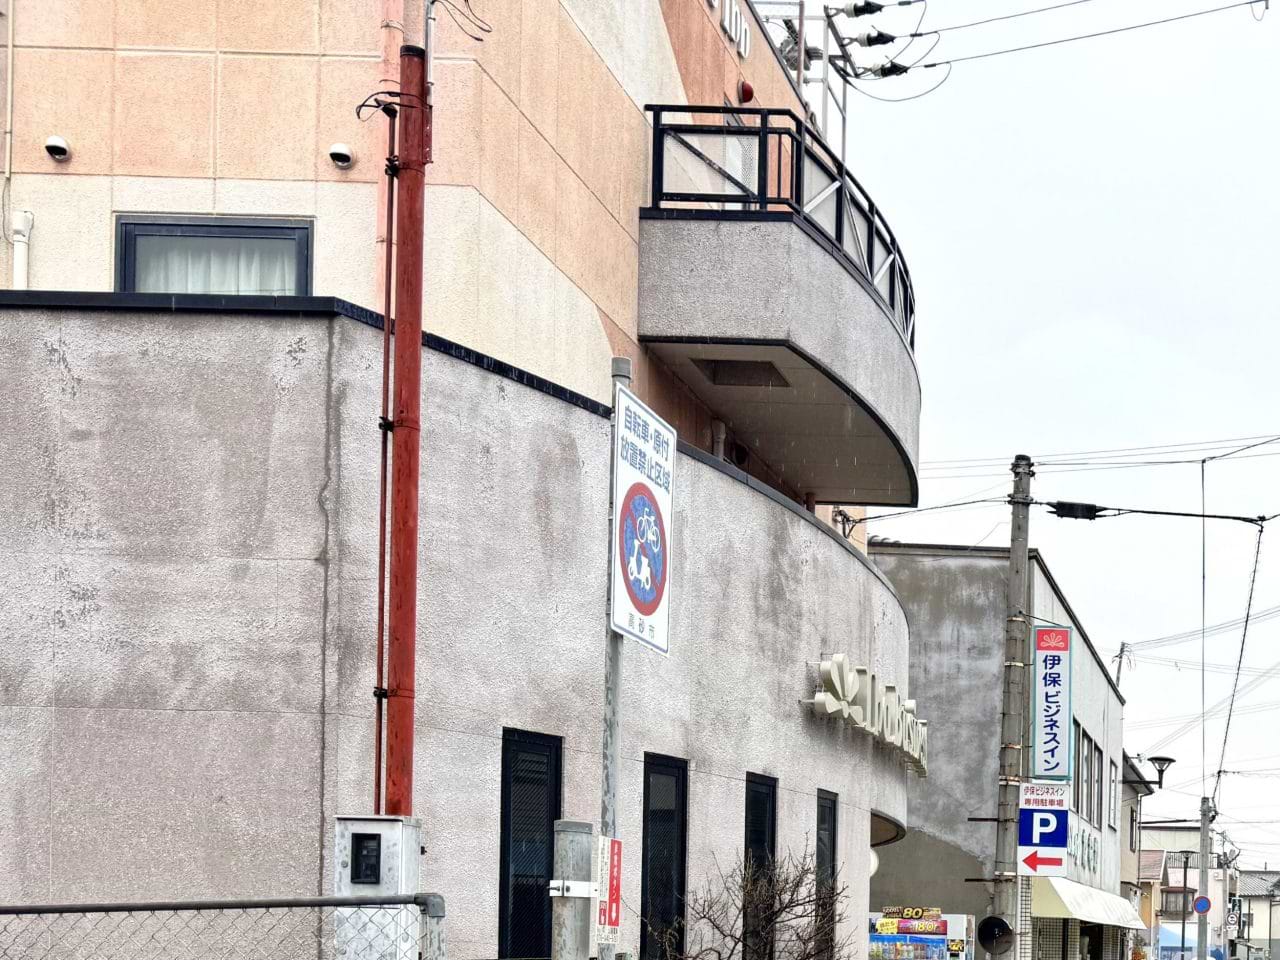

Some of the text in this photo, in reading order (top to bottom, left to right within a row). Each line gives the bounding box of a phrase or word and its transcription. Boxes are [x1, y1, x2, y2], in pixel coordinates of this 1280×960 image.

[620, 434, 671, 494] 放置禁止区域
[1042, 654, 1062, 772] 伊保ビジネスイン
[1023, 786, 1065, 797] 伊保ビジネスイン
[1032, 812, 1057, 844] P
